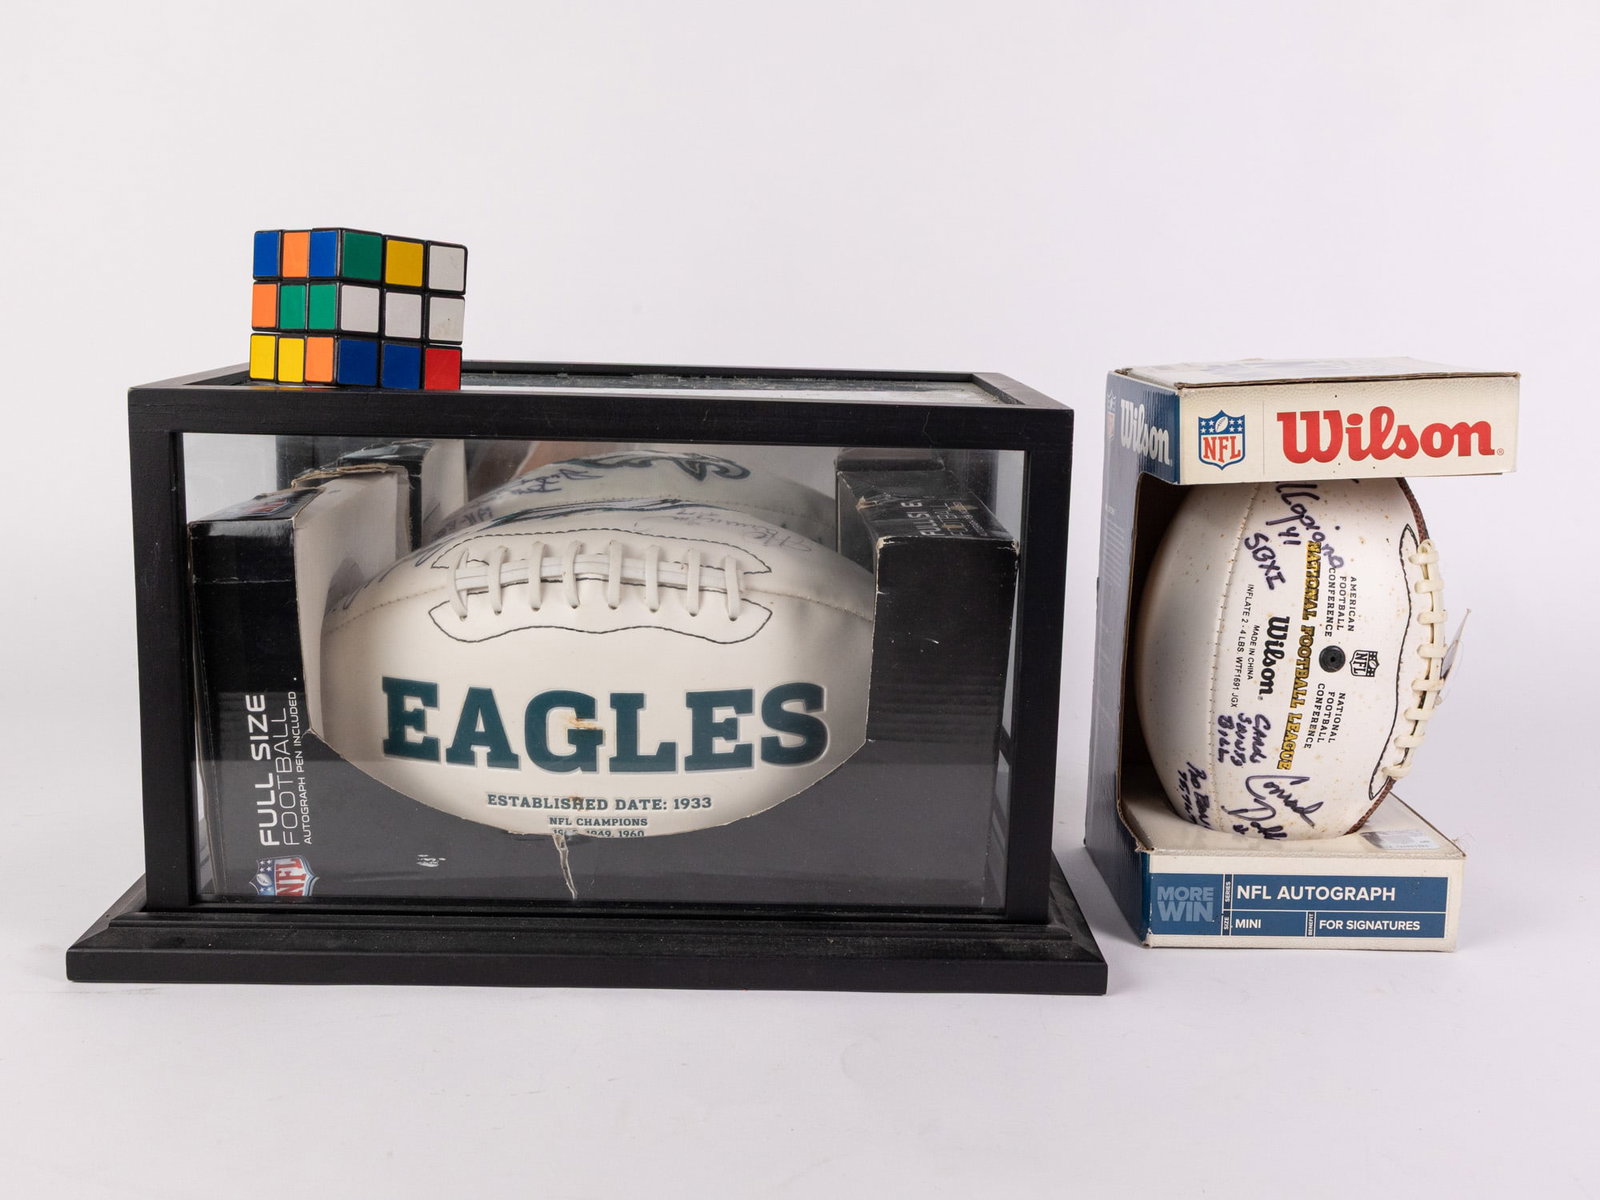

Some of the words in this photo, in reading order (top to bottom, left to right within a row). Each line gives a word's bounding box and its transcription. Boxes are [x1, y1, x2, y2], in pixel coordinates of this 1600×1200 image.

[1120, 399, 1170, 466] Wilson
[1202, 435, 1241, 463] NFL
[1277, 405, 1495, 464] Wilson
[1242, 583, 1254, 616] INFLATE
[1302, 540, 1322, 620] NATIONAL
[1325, 568, 1336, 637] CONFERENCE
[1337, 576, 1347, 631] FOOTBALL
[1347, 576, 1357, 632] AMERICAN
[1248, 647, 1256, 656] IN
[1249, 624, 1260, 646] MADE
[1259, 616, 1290, 695] Wilson
[1247, 657, 1255, 680] CHINA
[1290, 624, 1315, 708] FOOTBALL
[1353, 653, 1368, 675] NFL
[288, 691, 302, 747] INCLUDED
[382, 675, 829, 774] EAGLES
[1230, 692, 1239, 708] JGX
[1304, 683, 1325, 749] CONFERENCE
[1317, 691, 1336, 743] FOOTBALL
[1328, 692, 1346, 743] NATIONAL
[245, 694, 272, 761] SIZE
[1277, 713, 1302, 770] LEAGUE
[271, 708, 301, 846] FOOTBALL
[296, 750, 304, 773] PEN
[255, 773, 280, 846] FULL
[298, 777, 312, 845] AUTOGRAPH
[487, 794, 608, 810] ESTABLISHED
[615, 798, 668, 811] DATE:
[673, 797, 712, 809] 1933
[549, 817, 572, 826] NFL
[576, 818, 648, 826] CHAMPIONS
[618, 830, 645, 838] 1960
[275, 857, 306, 896] NFL
[1157, 886, 1215, 901] MORE
[1237, 885, 1271, 900] NFL
[1277, 885, 1396, 901] AUTOGRAPH
[1157, 901, 1214, 922] WIN
[1235, 919, 1262, 929] MINI
[1319, 919, 1343, 930] FOR
[1346, 920, 1420, 931] SIGNATURES
